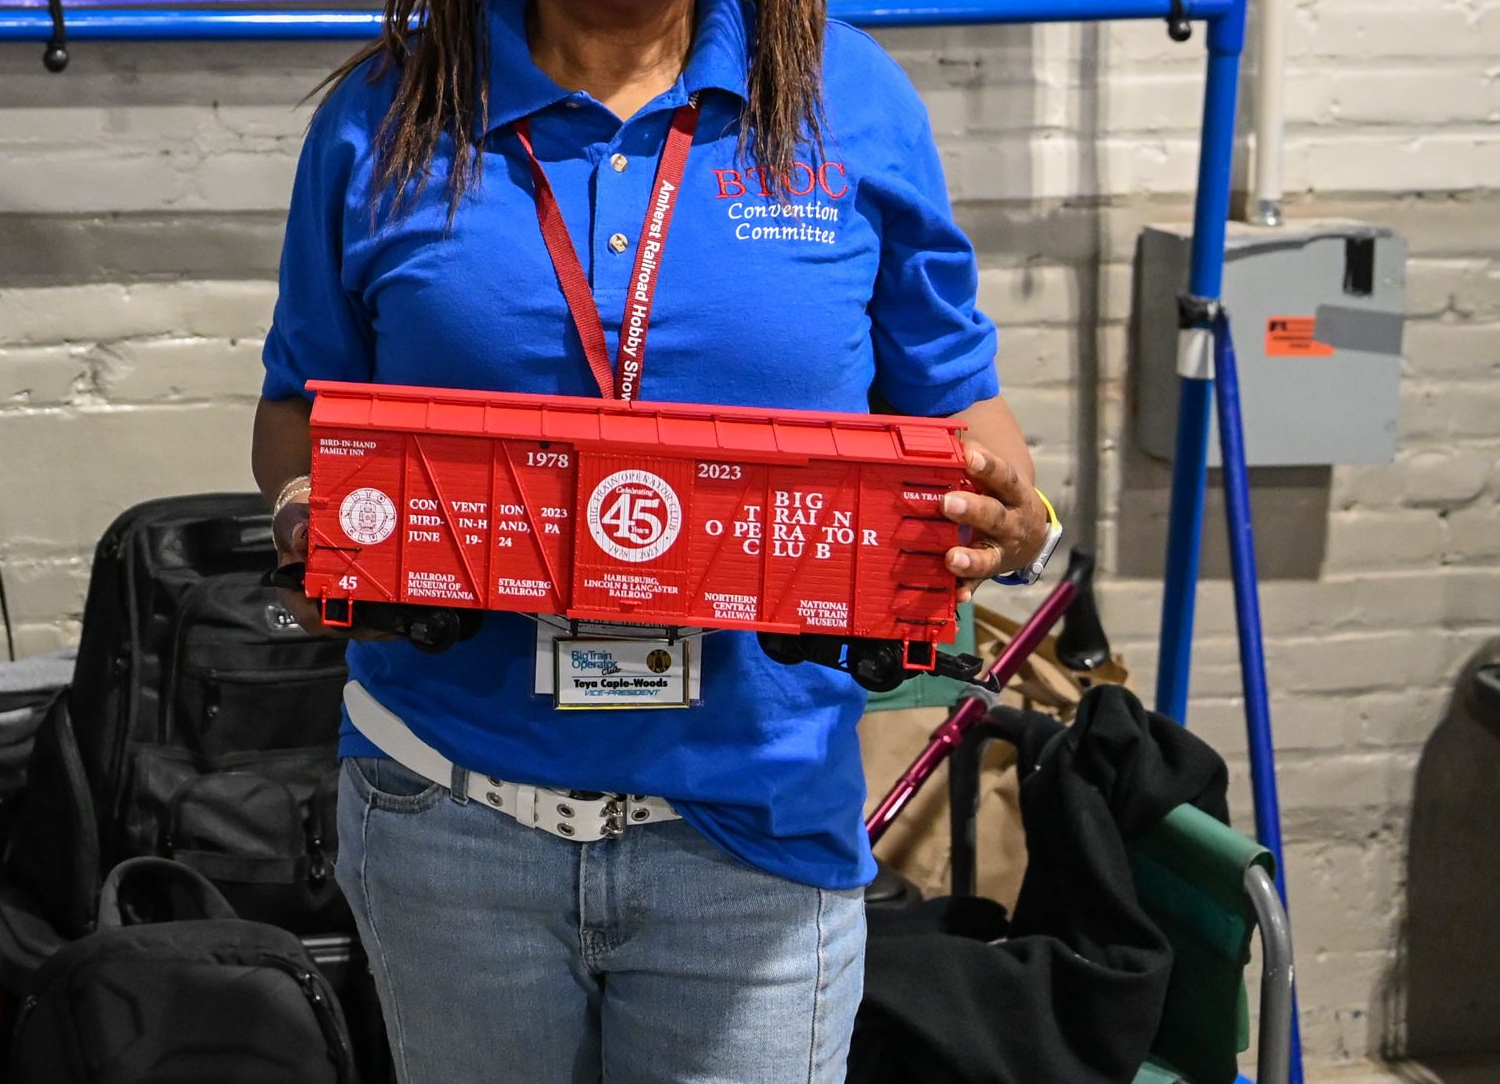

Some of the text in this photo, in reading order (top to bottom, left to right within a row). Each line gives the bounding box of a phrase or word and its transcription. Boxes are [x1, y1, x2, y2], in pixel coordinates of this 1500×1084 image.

[648, 179, 675, 238] Amherst
[728, 201, 839, 222] Convention
[735, 222, 836, 244] Committee
[635, 240, 660, 302] Railroad
[623, 303, 647, 357] Hobby
[320, 438, 377, 449] BIRD-IN-HAND
[320, 447, 365, 456] FAMILY INN
[526, 452, 569, 468] 1978
[698, 464, 742, 480] 2023
[774, 492, 823, 510] BIG
[903, 492, 920, 500] USA
[540, 507, 567, 518] 2023
[602, 494, 661, 545] 45
[544, 522, 560, 534] PA
[408, 530, 440, 543] JUNE
[338, 575, 357, 589] 45
[408, 571, 455, 582] RAILROAD
[408, 580, 461, 590] MUSEUM OF
[498, 578, 551, 589] STRASBURG
[584, 580, 678, 594] LINCOLN & LANCASTER
[408, 588, 474, 600] PENNSYLVANIA
[498, 587, 546, 596] RAILROAD
[609, 589, 653, 599] RAILROAD
[704, 592, 757, 604] NORTHERN
[713, 602, 756, 612] CENTRAL
[800, 600, 848, 610] NATIONAL
[714, 610, 756, 620] RAILWAY
[797, 607, 848, 619] TOY TRAIN
[806, 617, 847, 627] MUSEUM
[572, 659, 618, 671] Operator
